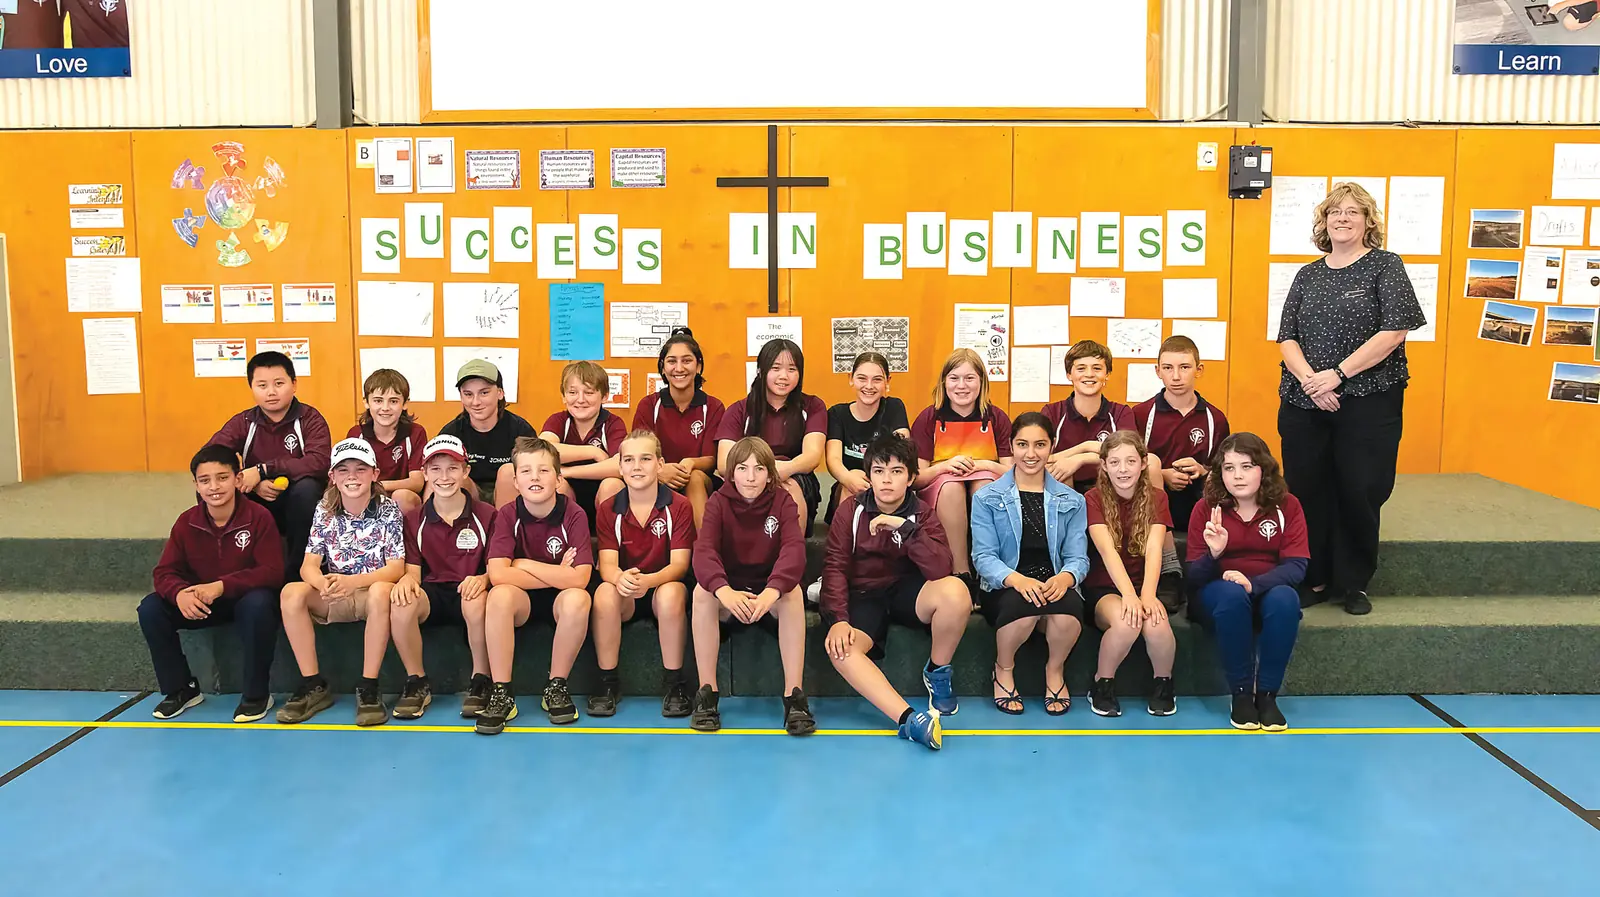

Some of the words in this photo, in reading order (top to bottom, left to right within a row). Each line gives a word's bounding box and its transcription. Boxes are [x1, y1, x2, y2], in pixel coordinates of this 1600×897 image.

[36, 53, 88, 74] Love
[1498, 50, 1561, 71] Learn
[360, 146, 370, 160] B
[1538, 211, 1575, 234] Drafts
[376, 215, 659, 271] SUCCESS
[753, 224, 815, 255] IN
[879, 221, 1203, 266] BUSINESS
[755, 332, 794, 341] economic
[333, 442, 370, 457] Titleist
